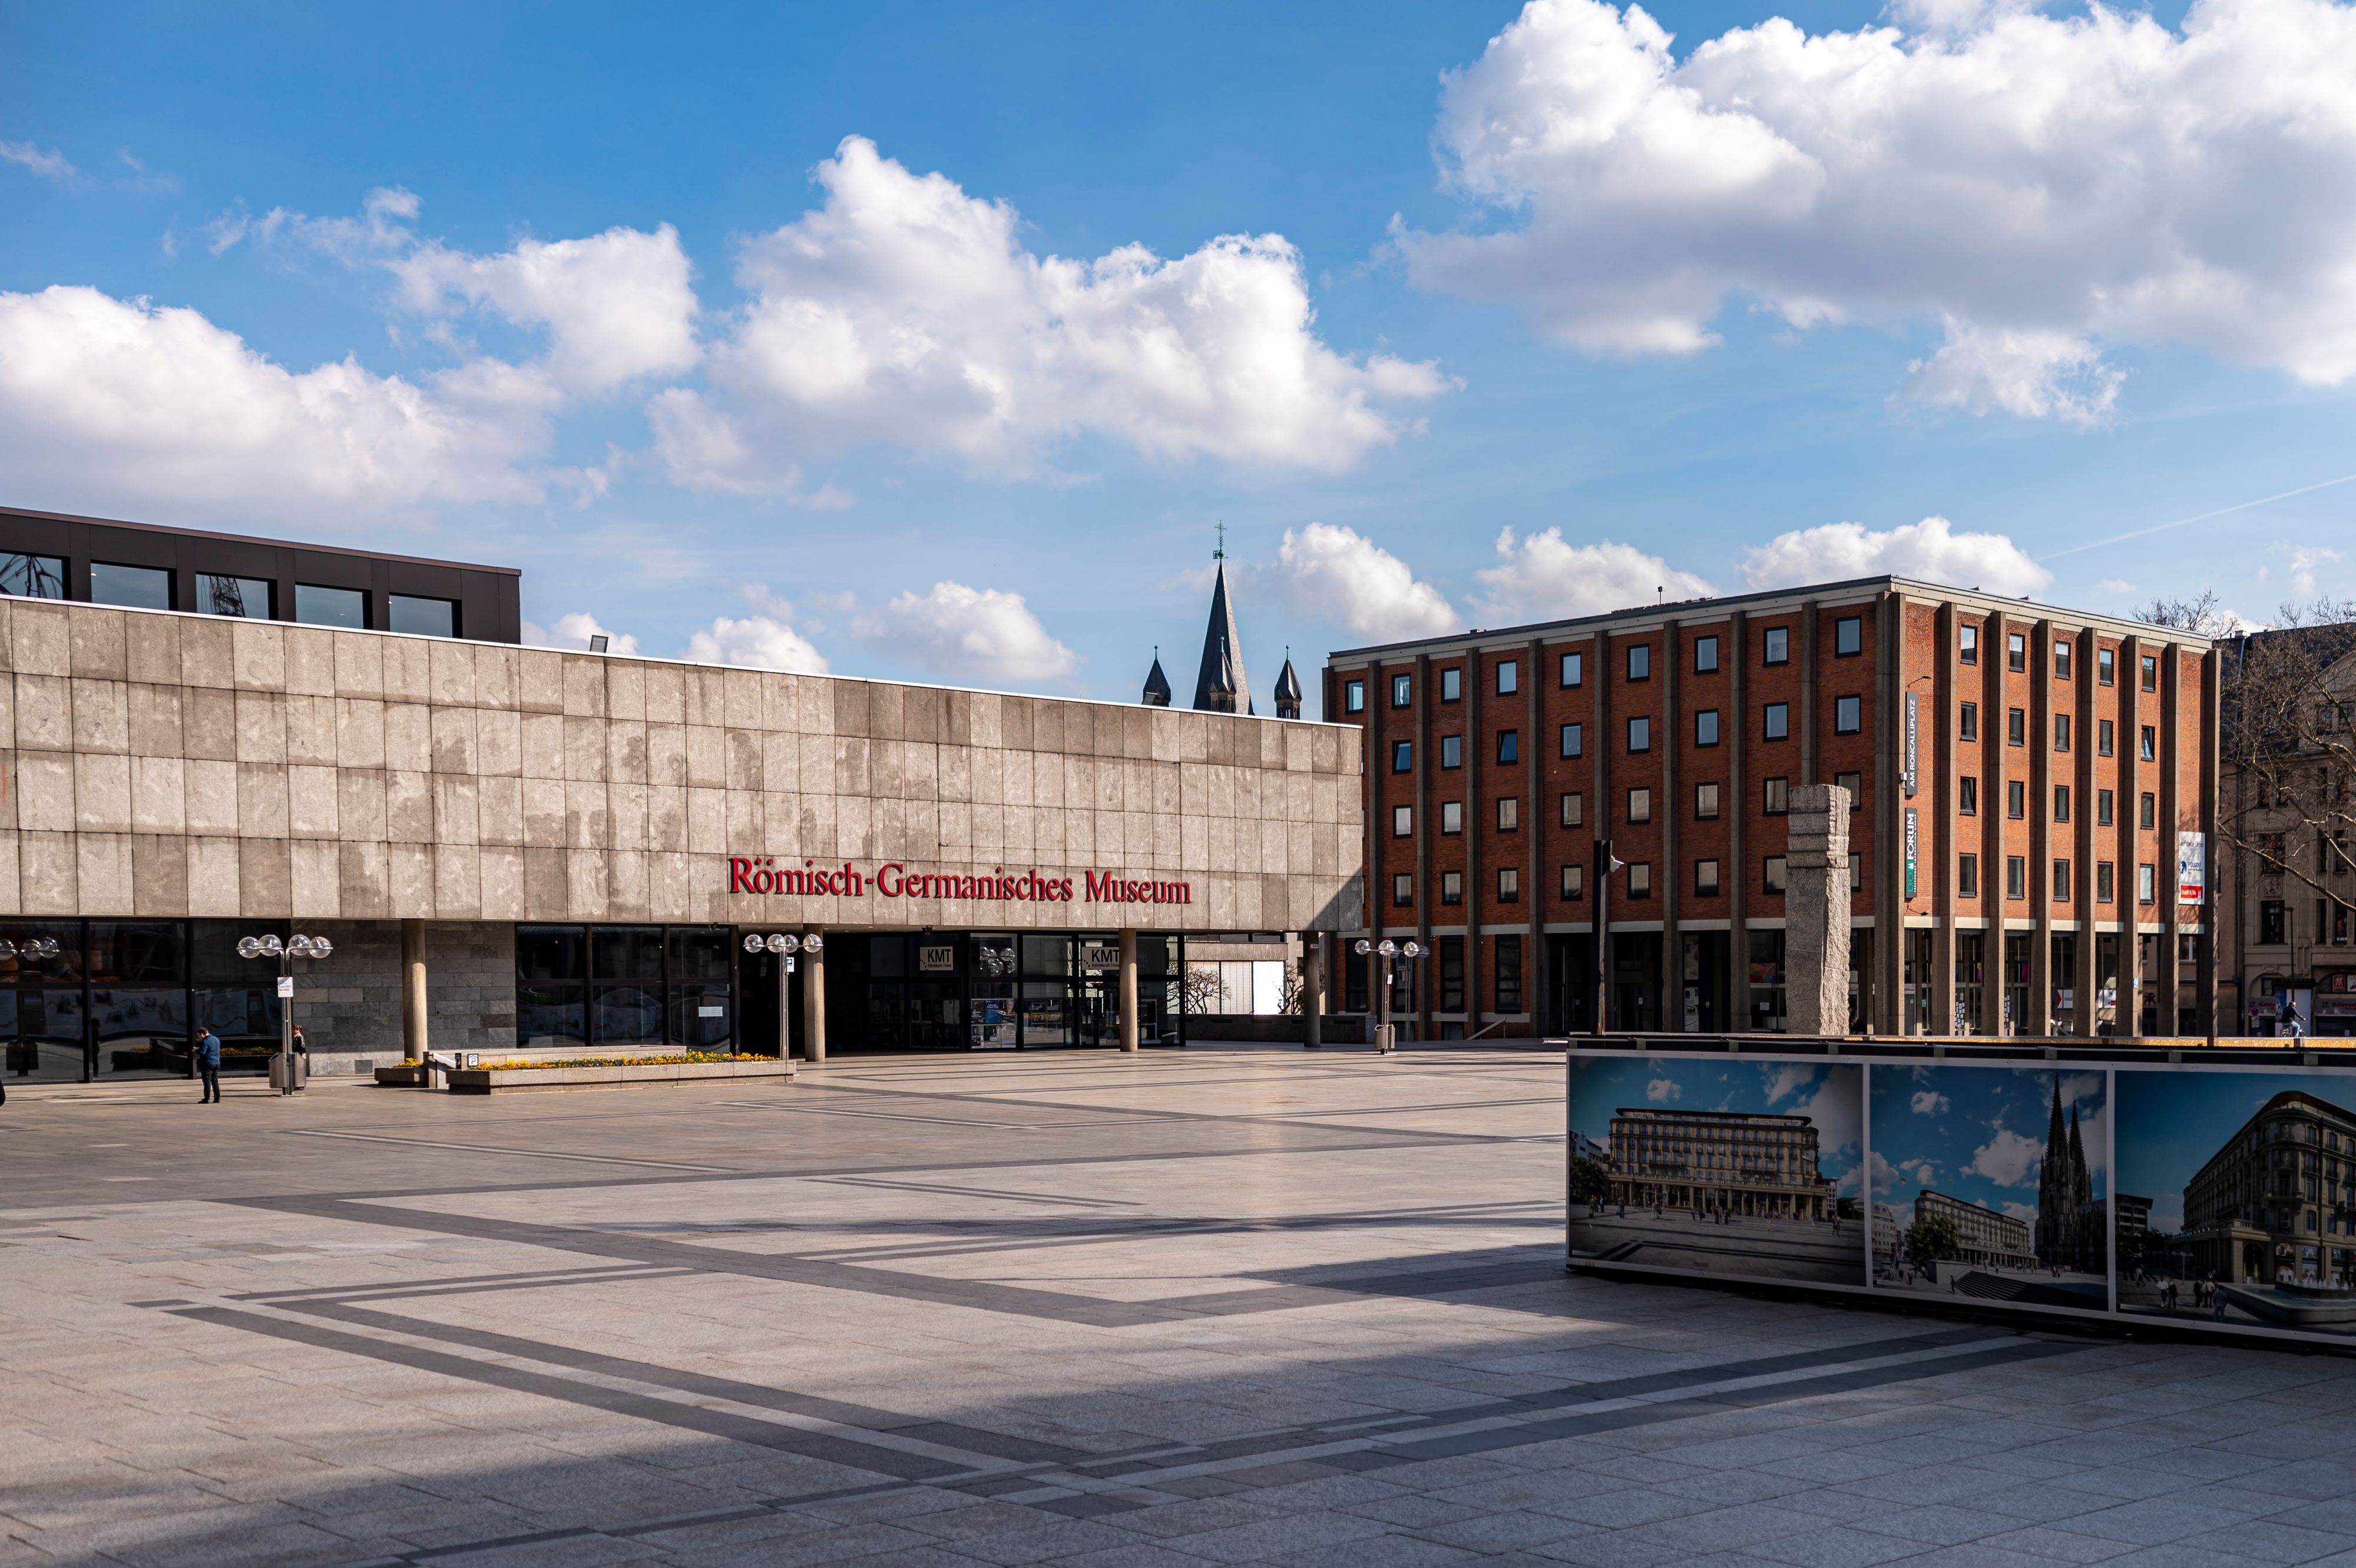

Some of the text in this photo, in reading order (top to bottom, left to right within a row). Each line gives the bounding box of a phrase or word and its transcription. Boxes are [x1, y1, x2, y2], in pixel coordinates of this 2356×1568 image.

[1910, 773, 1915, 788] AM
[729, 857, 1192, 904] Römisch-Germanisches Museum
[928, 949, 951, 962] KMT
[1091, 949, 1120, 962] KMT
